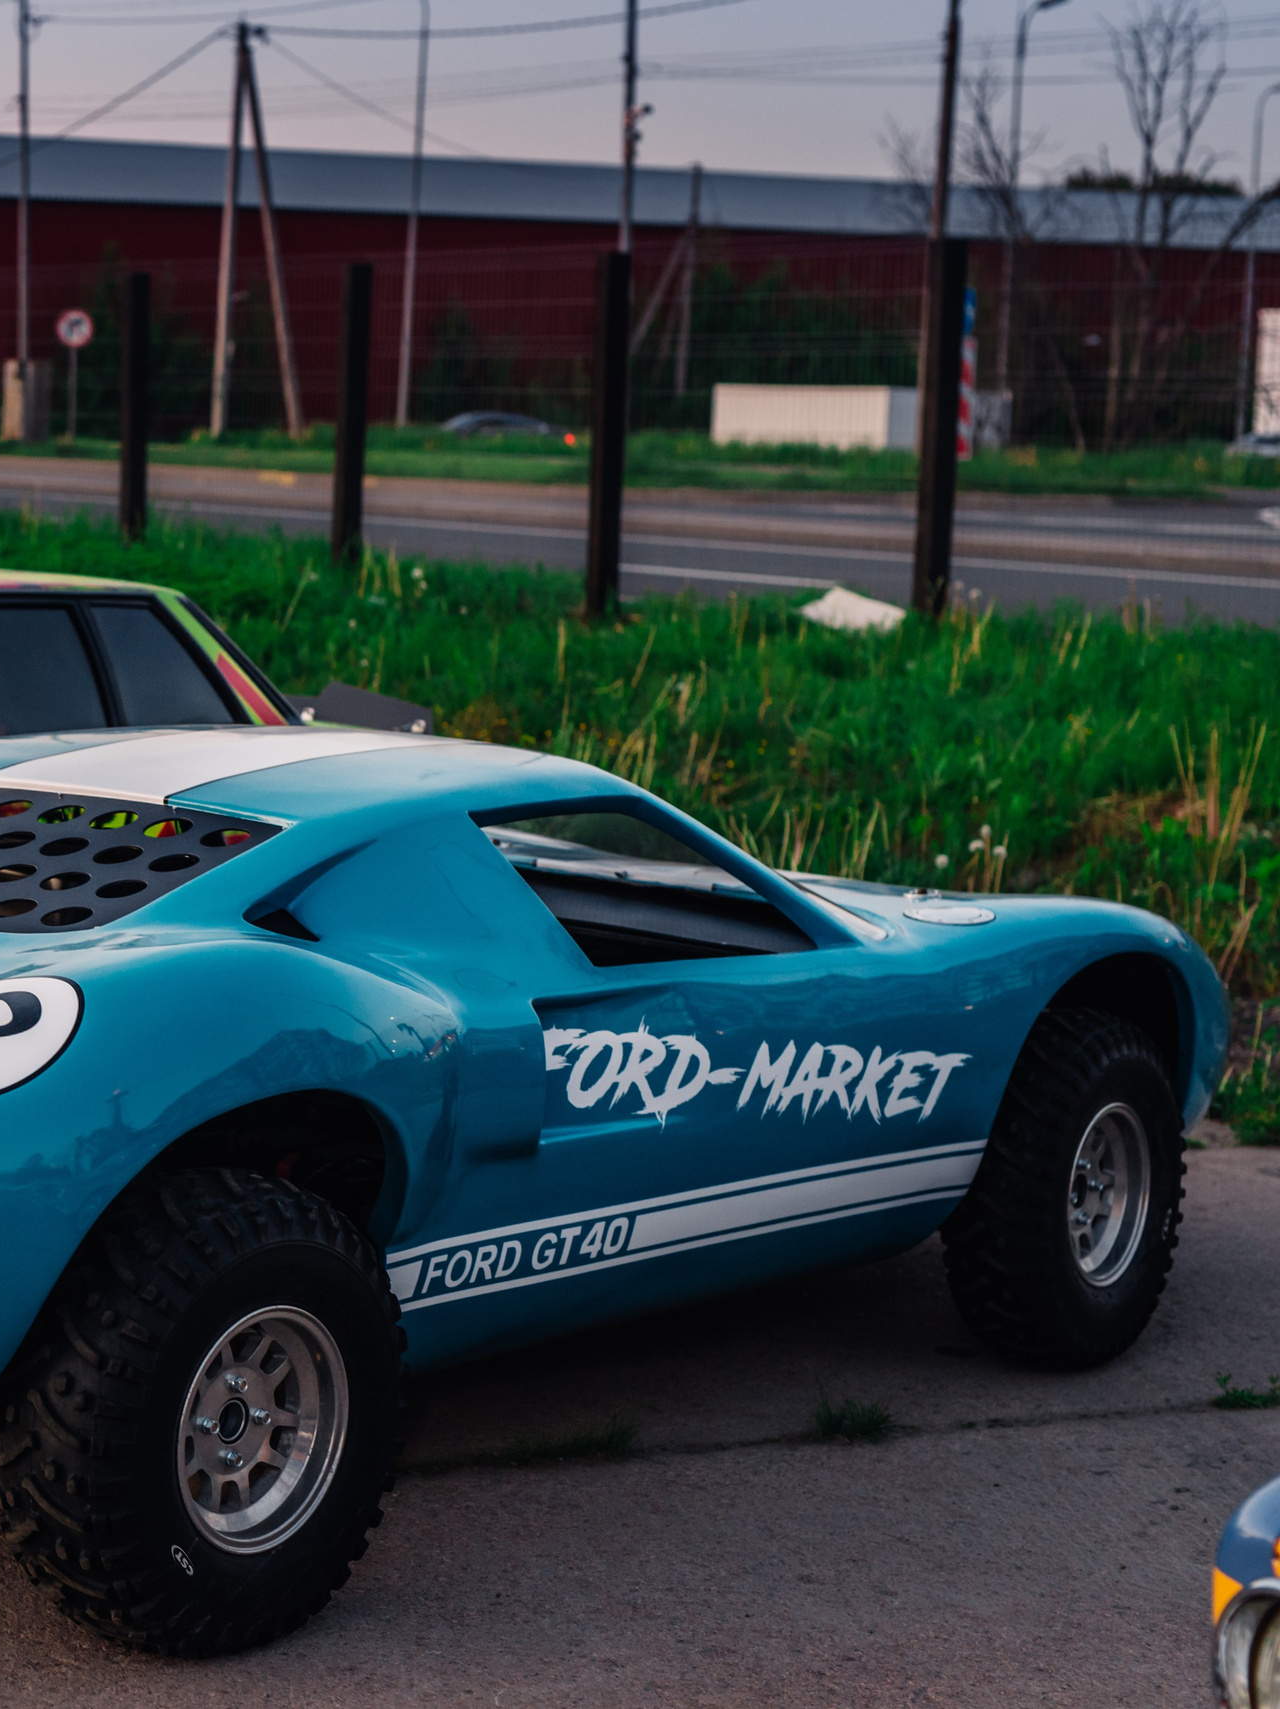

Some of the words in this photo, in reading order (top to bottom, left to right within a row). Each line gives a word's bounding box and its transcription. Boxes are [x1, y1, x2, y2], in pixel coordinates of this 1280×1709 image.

[543, 1015, 973, 1134] FORD-MARKET
[421, 1239, 522, 1294] FORD
[175, 1551, 194, 1576] CST
